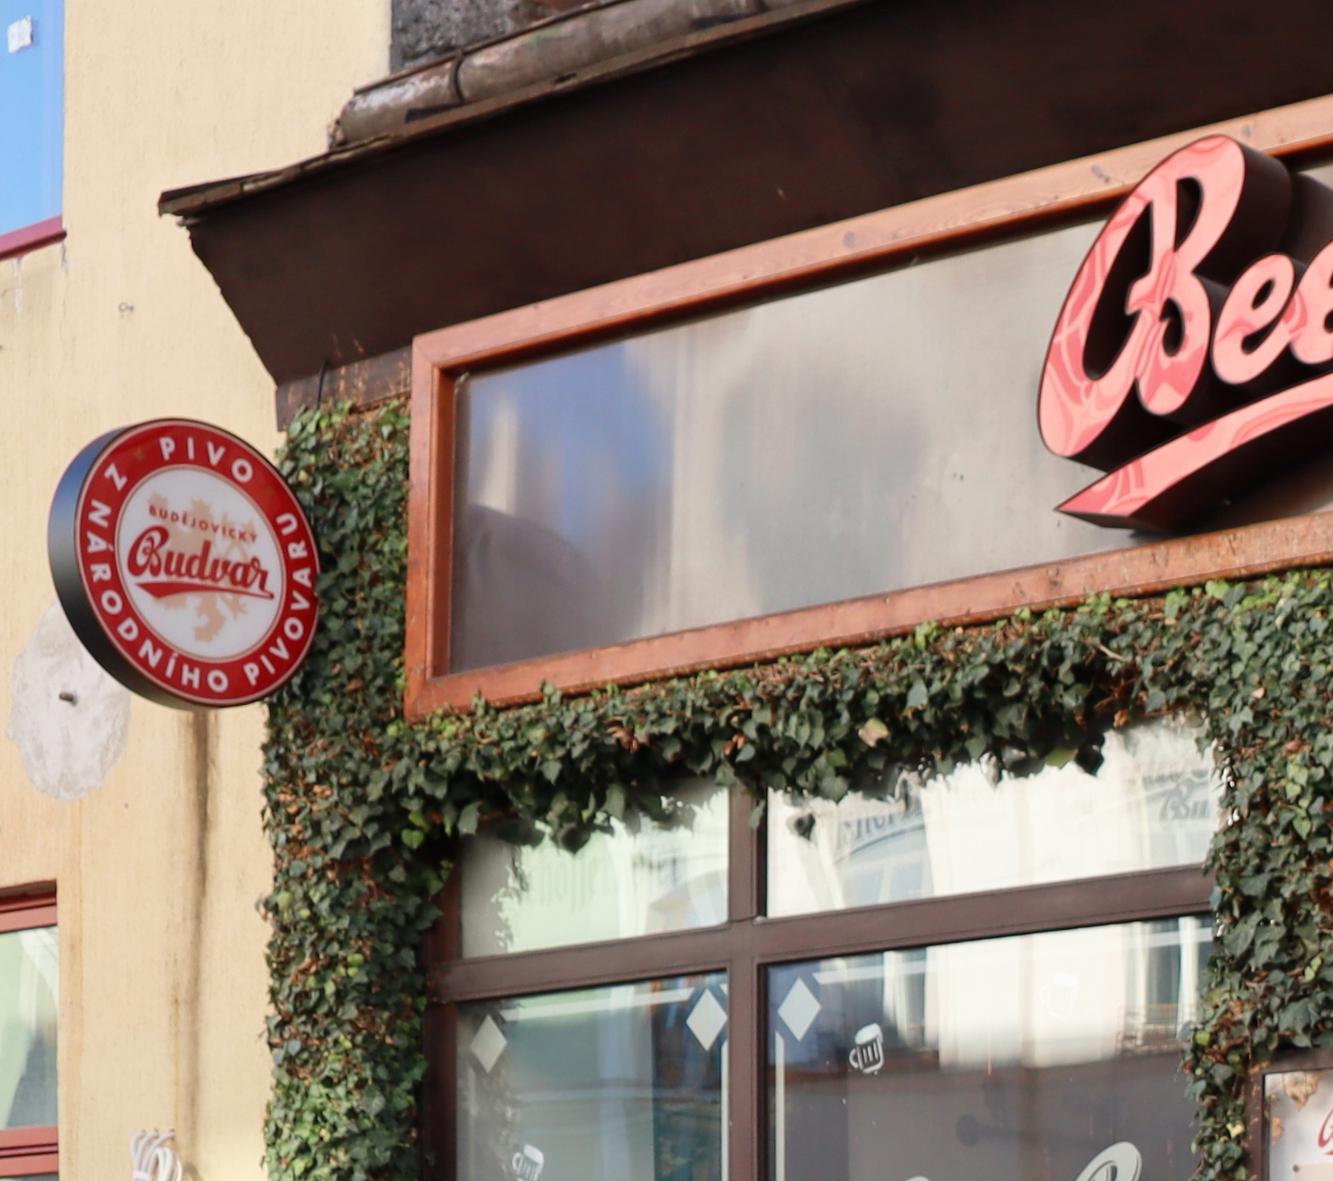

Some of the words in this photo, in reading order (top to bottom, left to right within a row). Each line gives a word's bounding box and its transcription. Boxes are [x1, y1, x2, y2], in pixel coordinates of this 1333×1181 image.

[159, 436, 253, 483] PIVO
[148, 505, 257, 544] BUDĚJOVICKÝ
[87, 499, 228, 692] NÁRODNÍHO
[128, 525, 273, 598] Budvar
[243, 512, 312, 685] PIVOVARU
